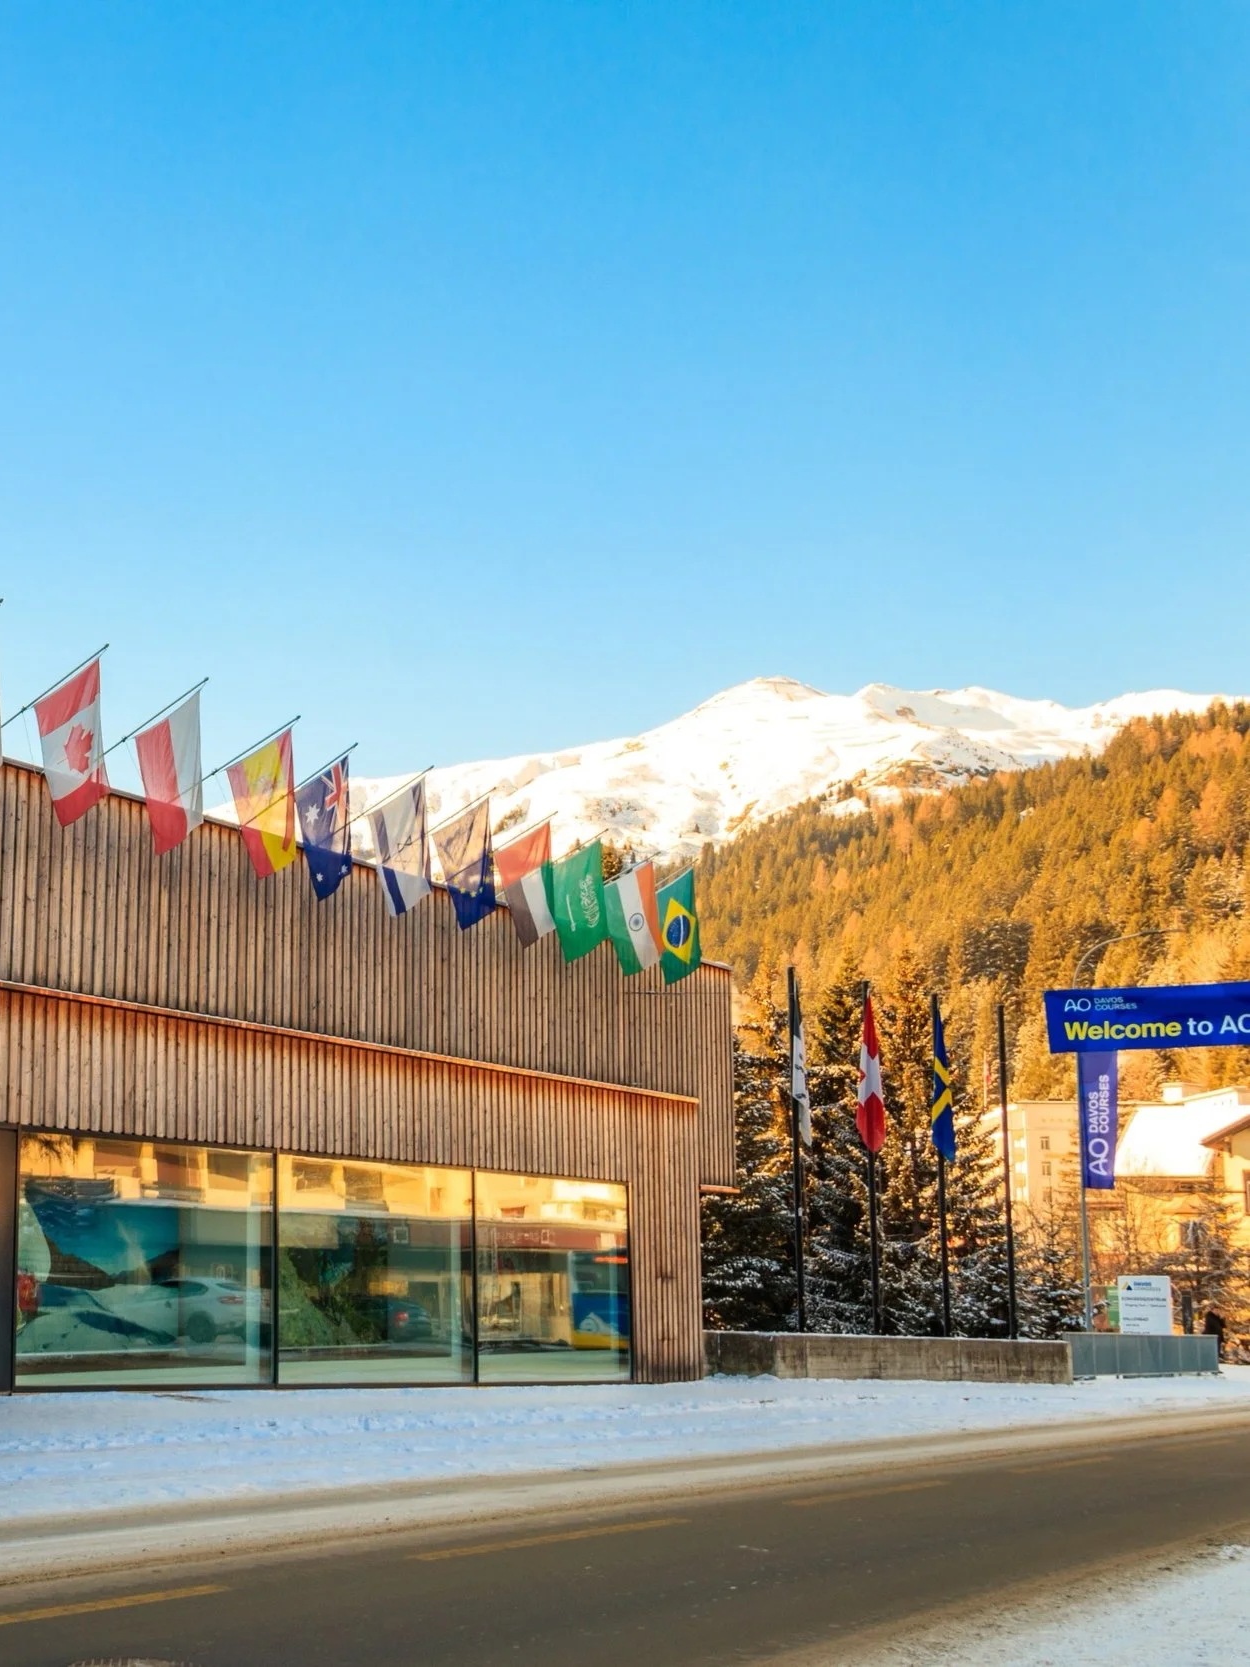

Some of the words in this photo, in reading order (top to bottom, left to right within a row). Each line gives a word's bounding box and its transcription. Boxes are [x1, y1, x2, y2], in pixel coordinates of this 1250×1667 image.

[1064, 998, 1092, 1012] AO
[1094, 996, 1124, 1004] DAVOS
[1094, 1003, 1138, 1011] COURSES
[1064, 1020, 1182, 1041] Welcome
[1187, 1017, 1214, 1036] to
[1088, 1091, 1099, 1133] DAVOS
[1098, 1074, 1110, 1134] COURSES
[1088, 1138, 1109, 1176] AO
